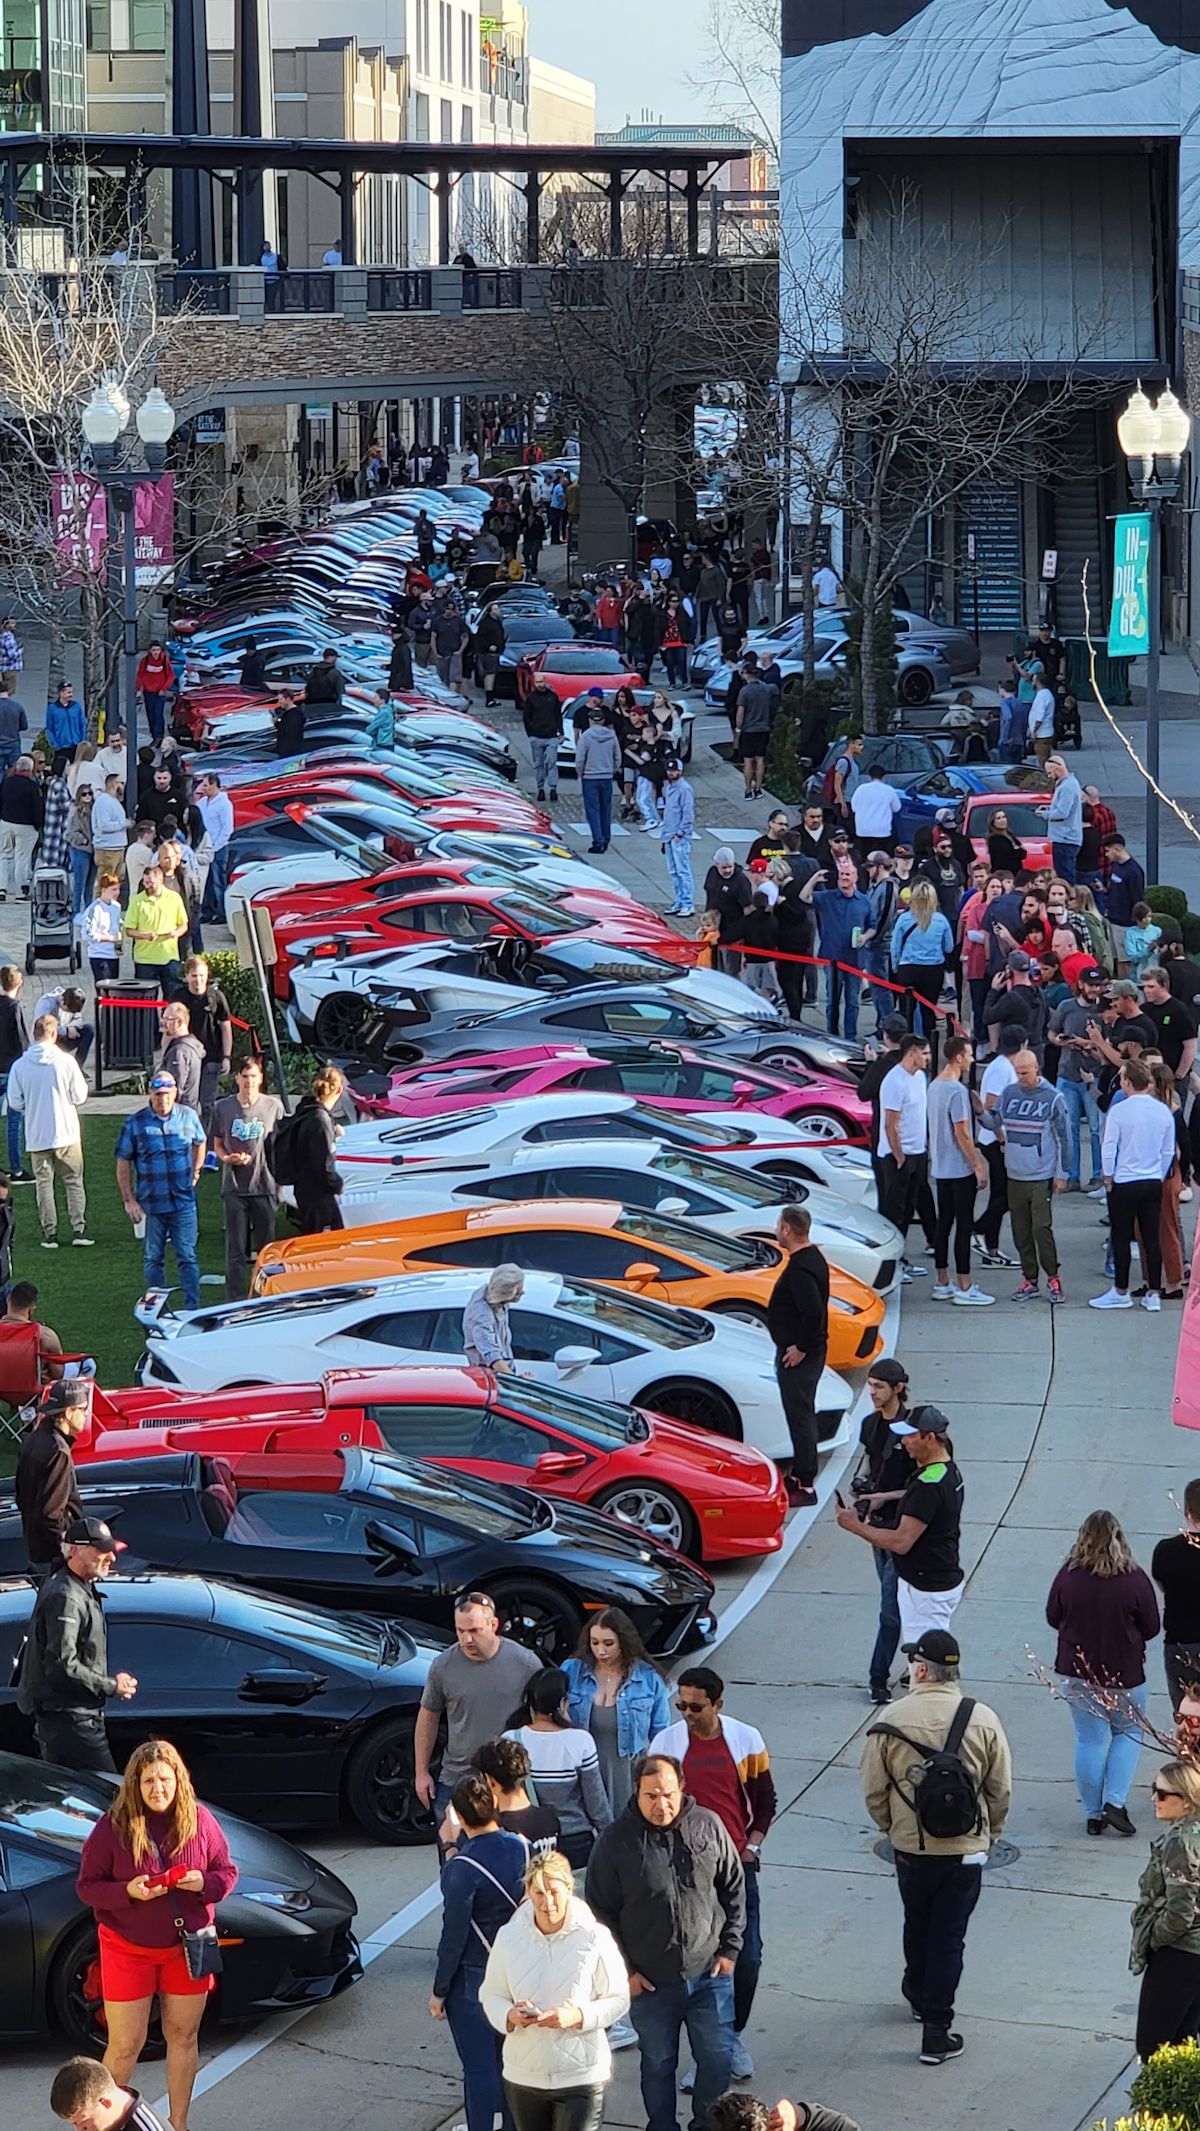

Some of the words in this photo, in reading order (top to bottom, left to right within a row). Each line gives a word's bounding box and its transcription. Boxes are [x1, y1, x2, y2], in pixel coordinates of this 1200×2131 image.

[134, 547, 163, 559] ATEWAY
[1126, 527, 1148, 561] IN-
[1114, 565, 1145, 599] DUL-
[1120, 599, 1140, 636] GE
[1006, 1098, 1049, 1117] FOX
